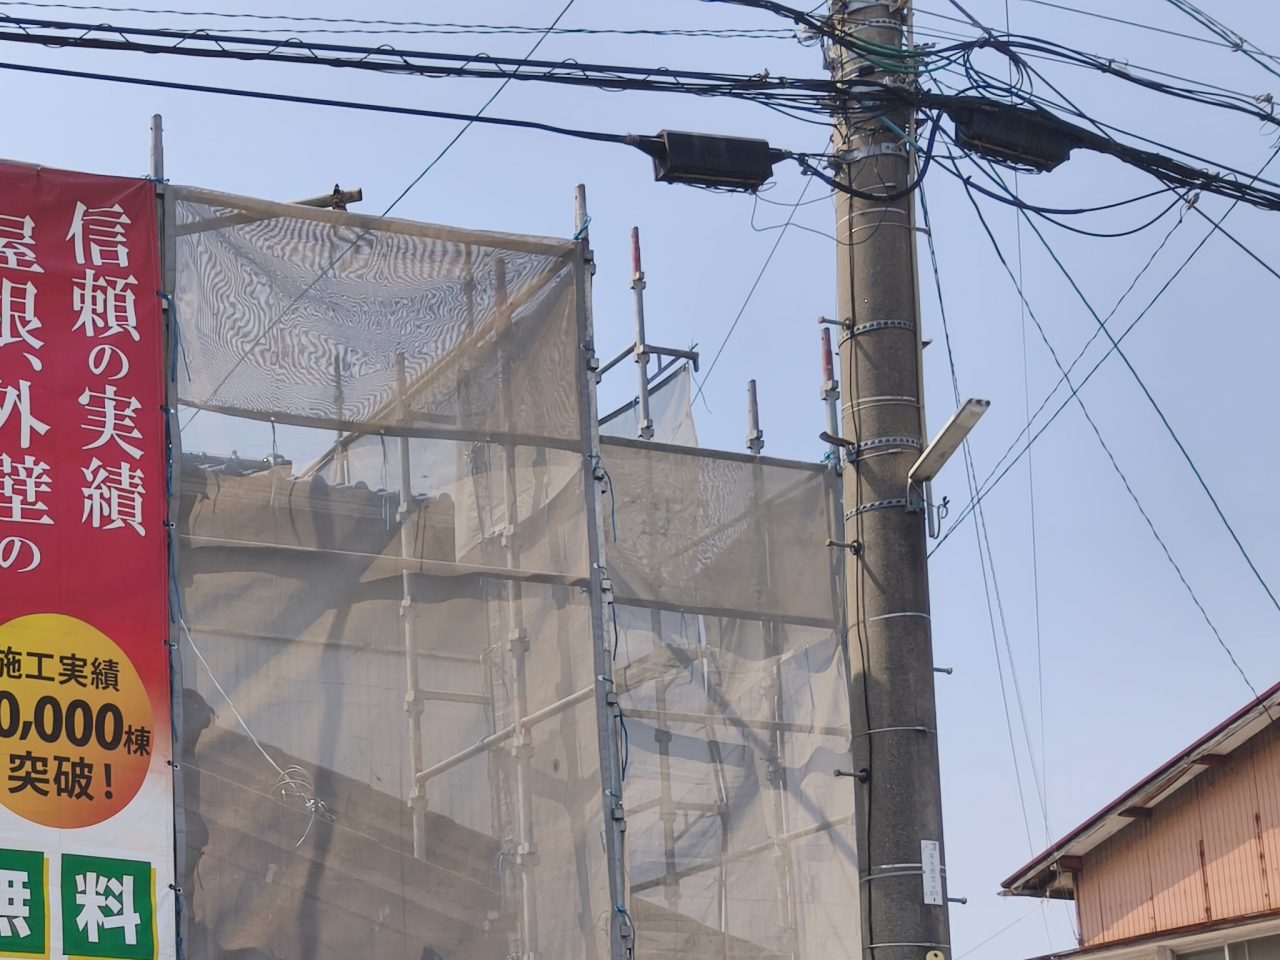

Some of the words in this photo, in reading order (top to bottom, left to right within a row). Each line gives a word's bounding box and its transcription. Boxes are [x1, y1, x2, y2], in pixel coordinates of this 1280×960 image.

[66, 201, 146, 536] 信頼の実績
[8, 751, 113, 801] 突破！
